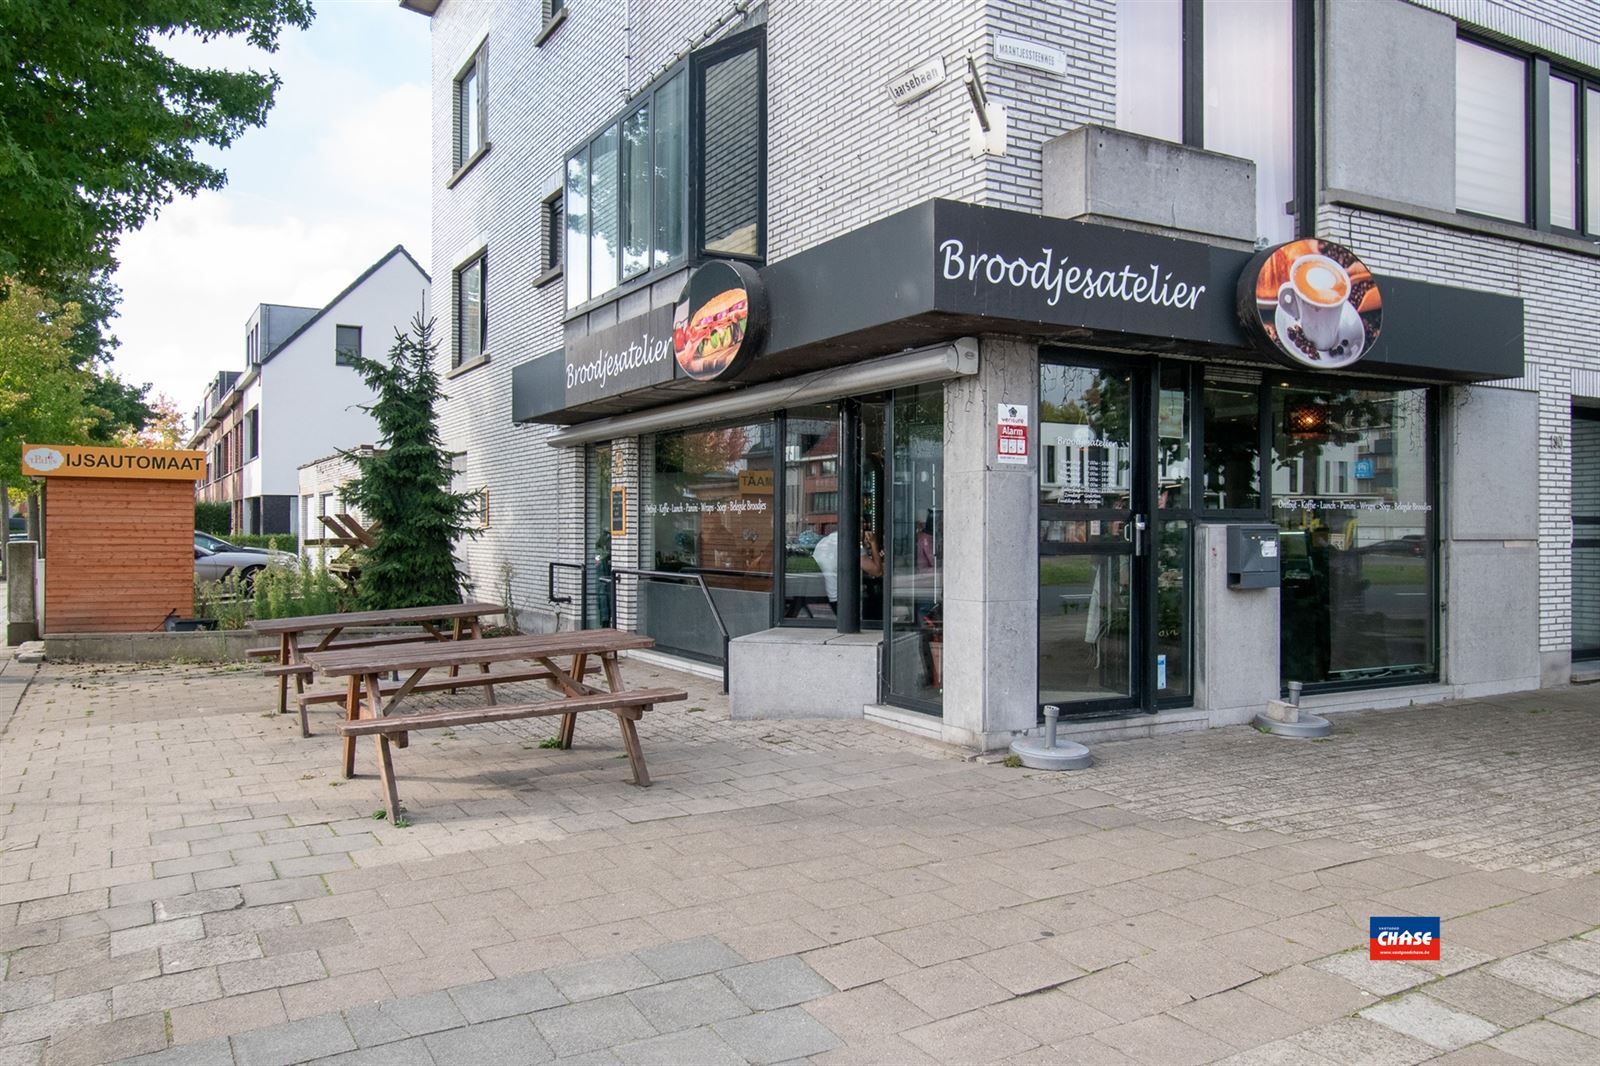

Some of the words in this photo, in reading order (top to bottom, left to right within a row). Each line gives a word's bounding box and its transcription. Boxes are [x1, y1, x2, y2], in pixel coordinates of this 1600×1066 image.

[939, 239, 1206, 311] Broodjesatelier
[566, 333, 673, 389] Broodjesatelier
[1002, 426, 1023, 436] Alarm
[66, 453, 203, 471] IJSAUTOMAAT
